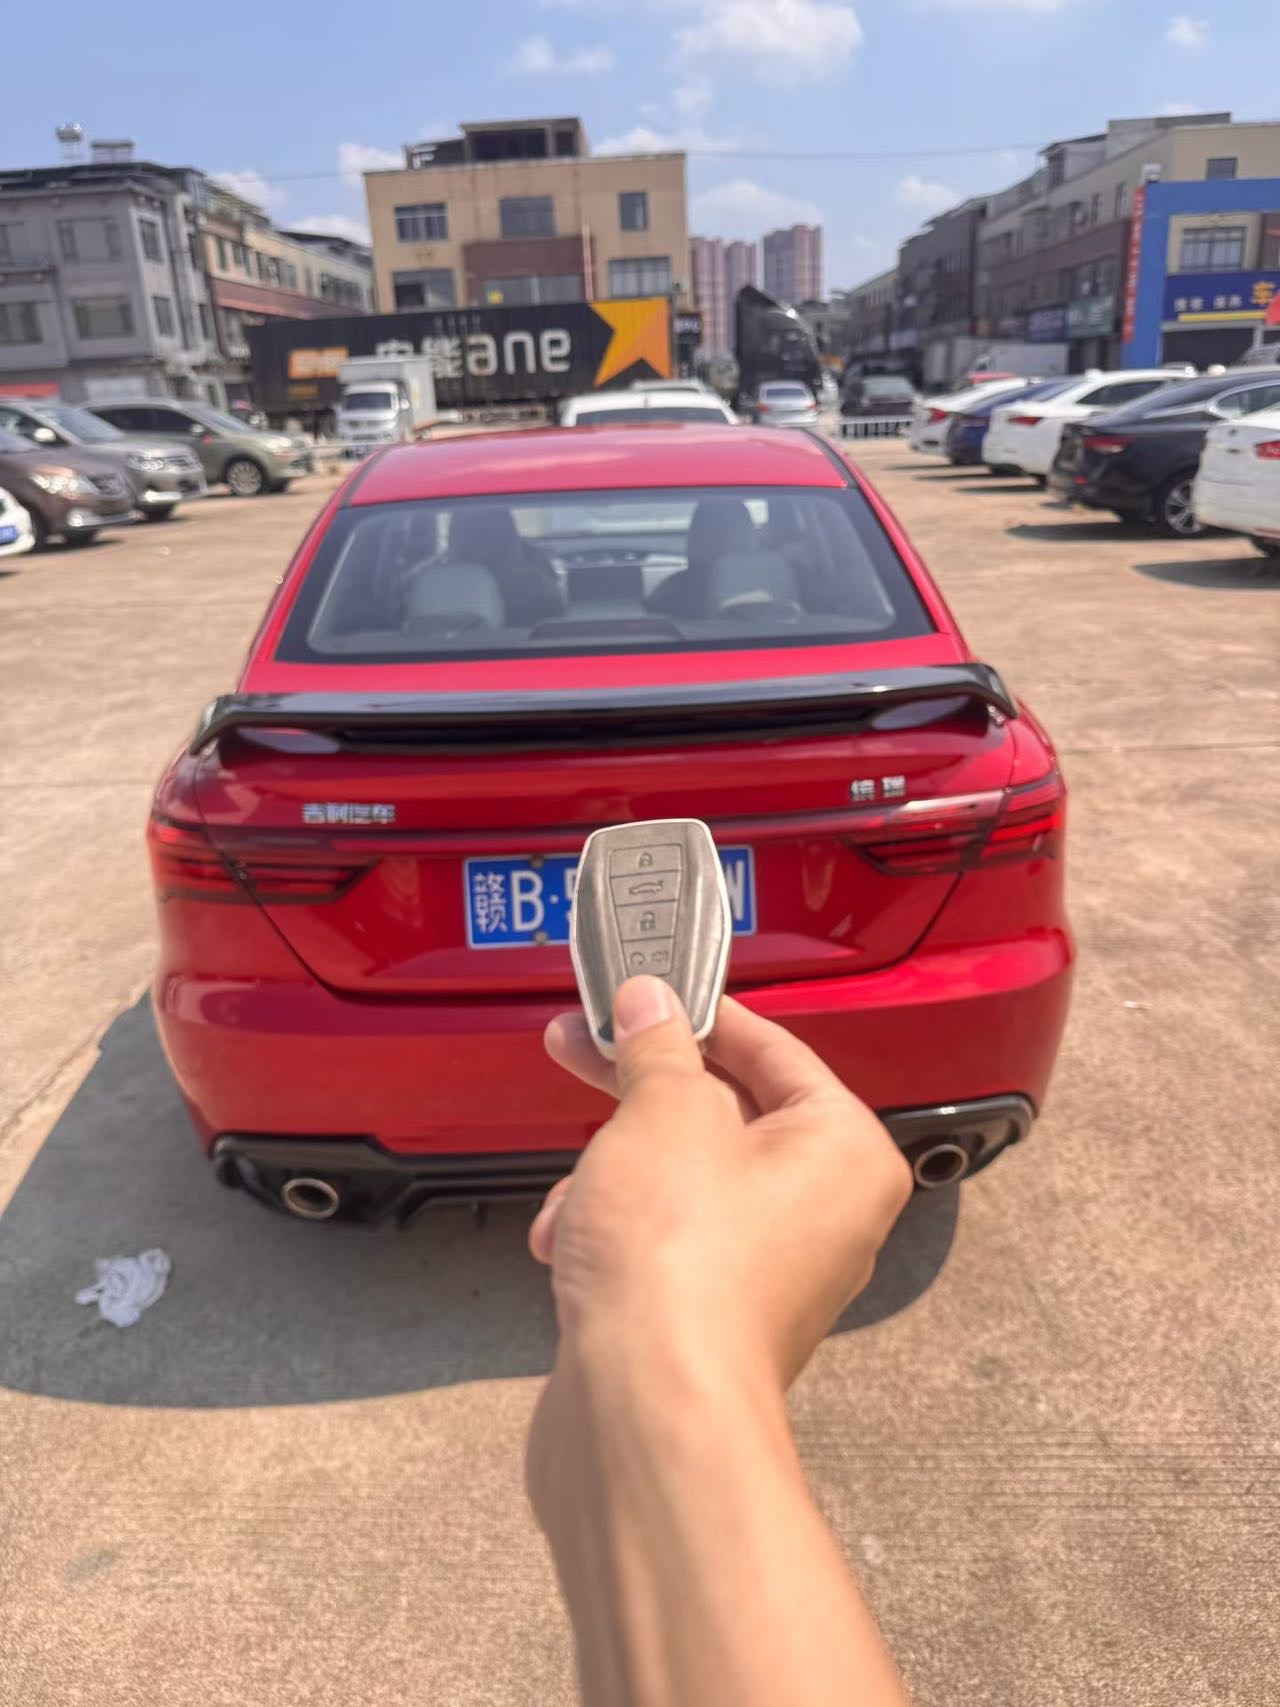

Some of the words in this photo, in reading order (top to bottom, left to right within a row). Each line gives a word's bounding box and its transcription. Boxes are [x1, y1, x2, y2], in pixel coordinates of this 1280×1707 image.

[467, 328, 571, 376] ane
[303, 803, 396, 824] 吉利汽车
